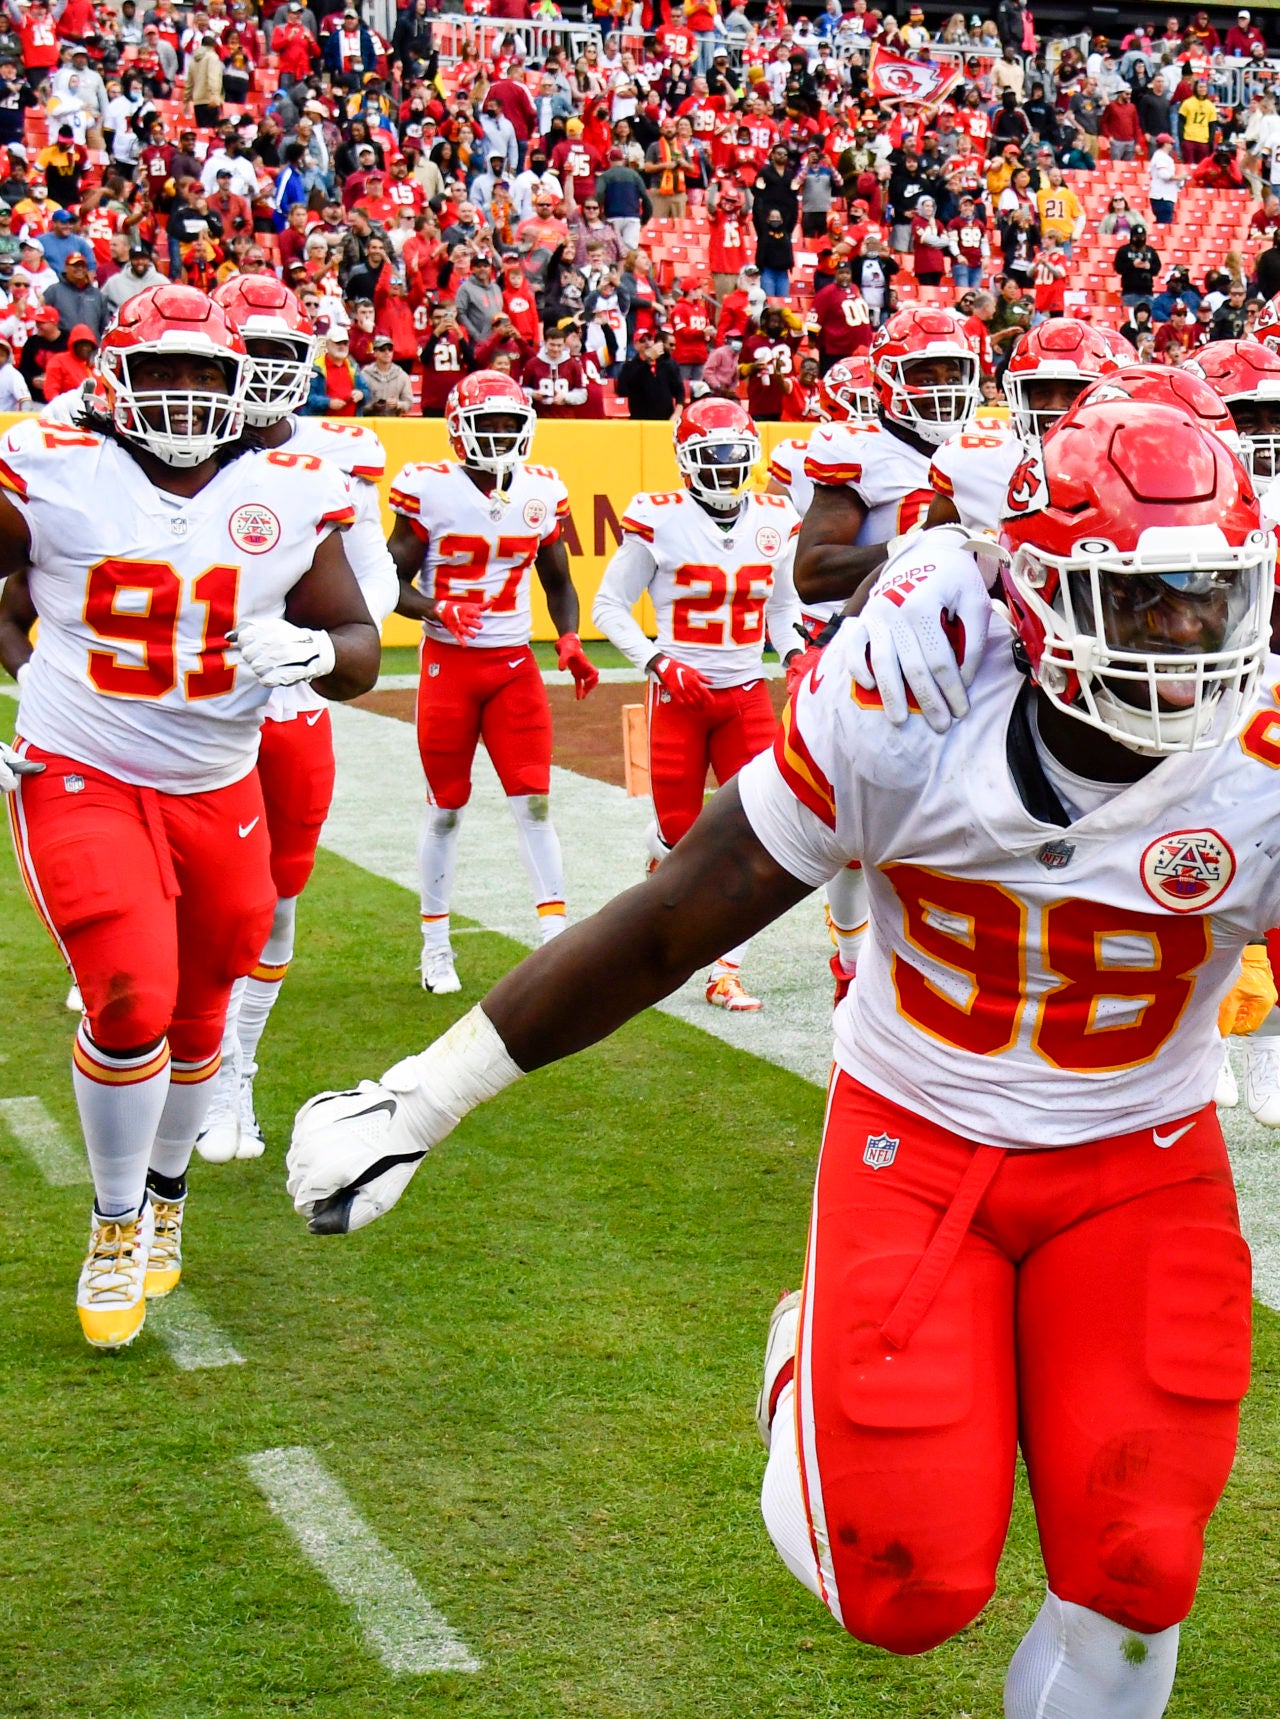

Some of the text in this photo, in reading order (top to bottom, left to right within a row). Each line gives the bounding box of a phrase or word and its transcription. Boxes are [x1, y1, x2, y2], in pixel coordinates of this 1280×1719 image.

[664, 35, 688, 54] 58
[151, 159, 167, 176] 21
[389, 184, 415, 205] 15
[1046, 200, 1064, 218] 21
[723, 222, 740, 248] 15
[434, 344, 461, 371] 21
[434, 534, 540, 614] 27
[672, 564, 774, 647] 26
[83, 557, 242, 701] 91
[1043, 852, 1065, 866] NFL
[876, 862, 1213, 1073] 98
[869, 1148, 890, 1162] NFL
